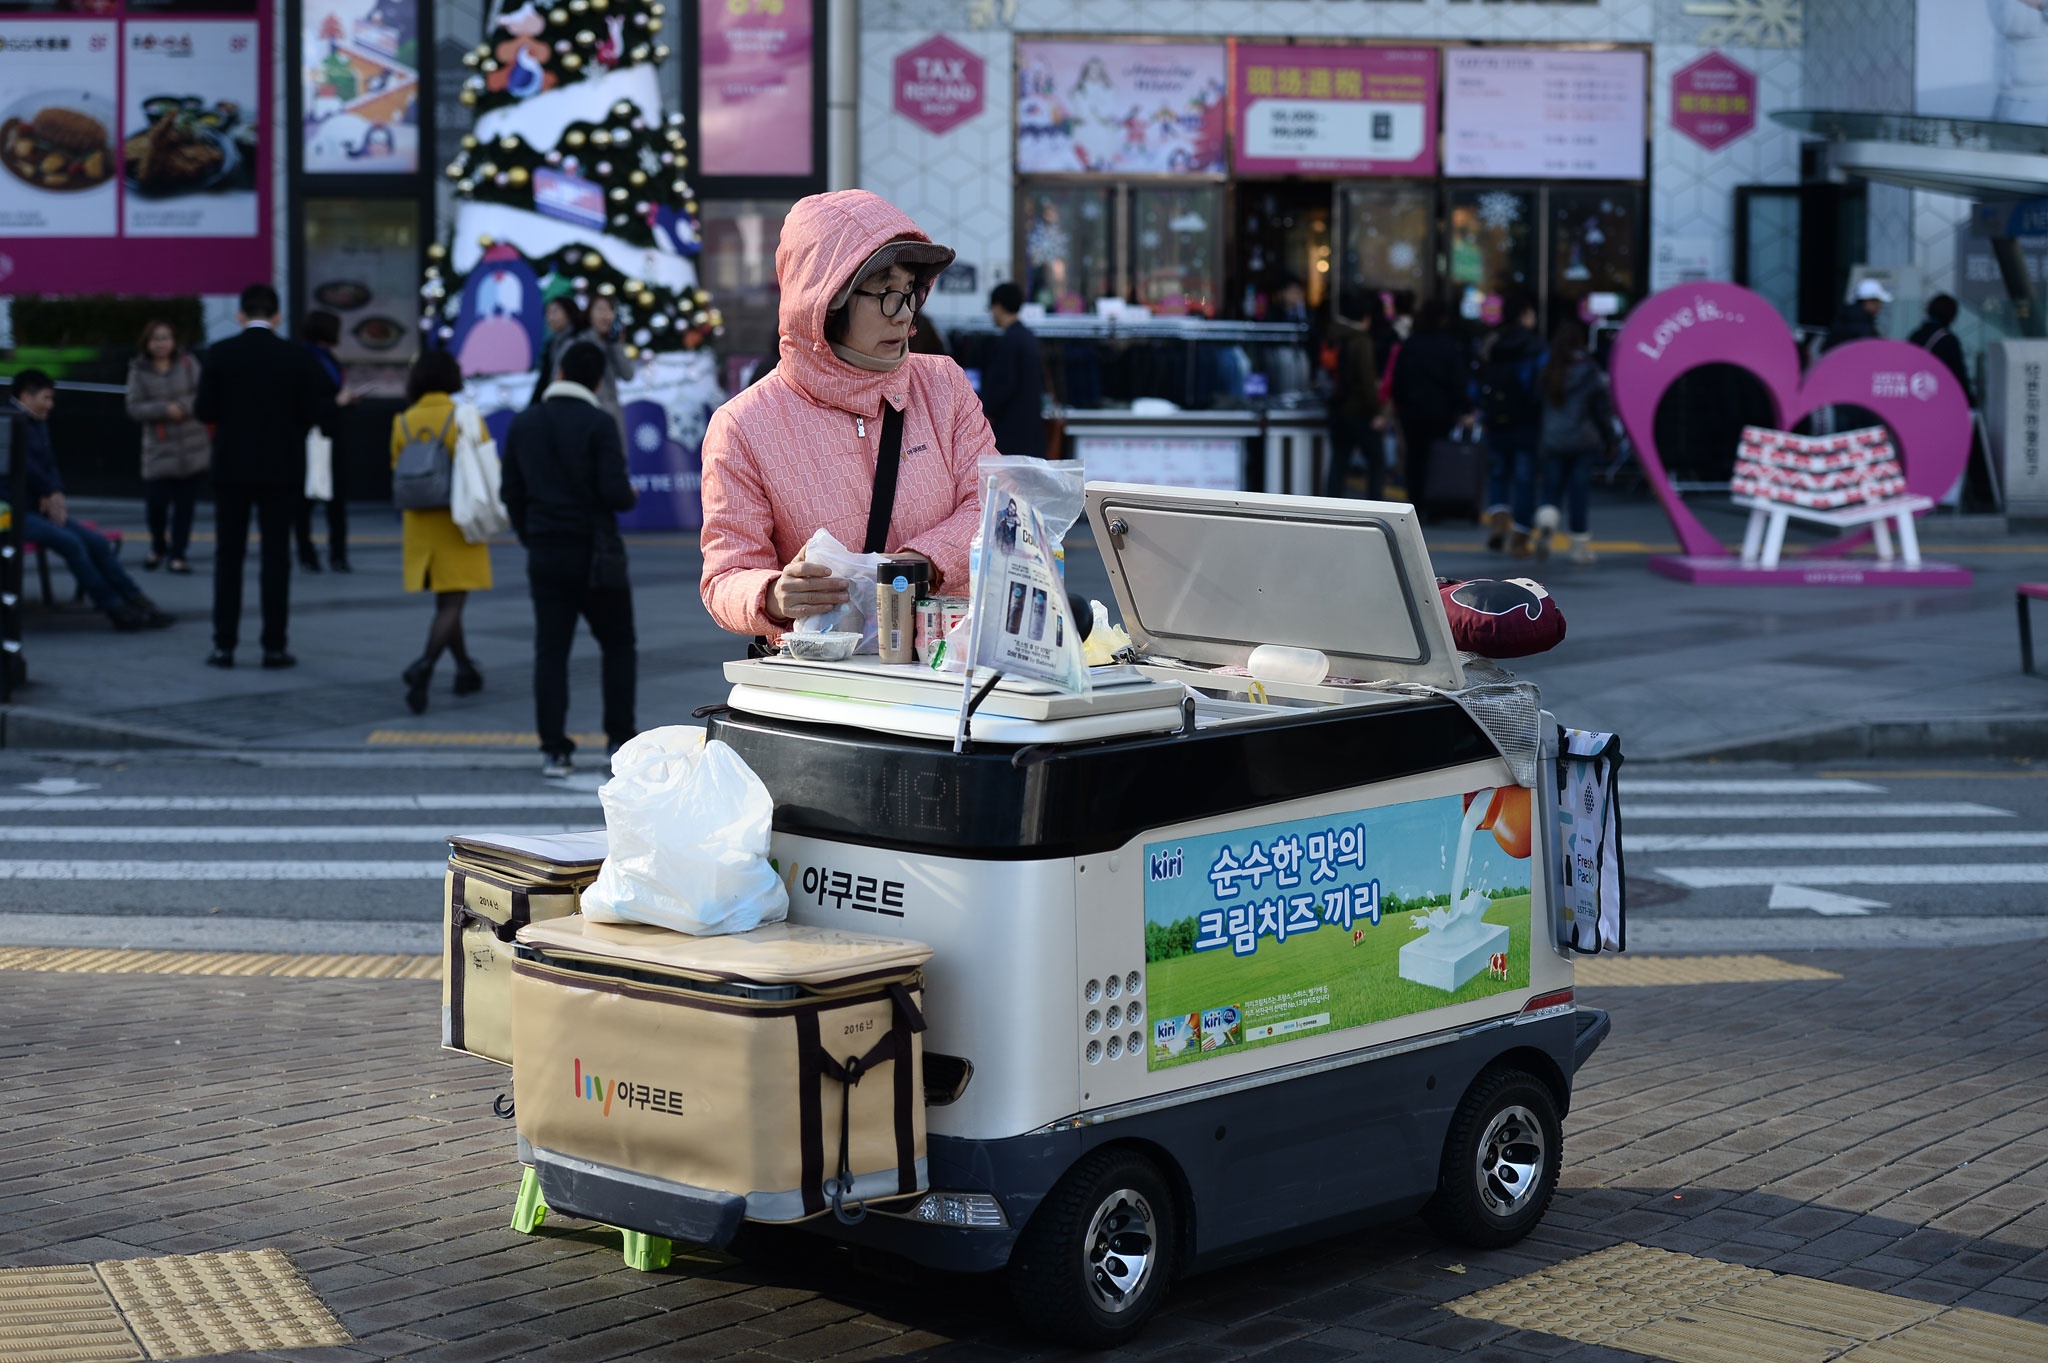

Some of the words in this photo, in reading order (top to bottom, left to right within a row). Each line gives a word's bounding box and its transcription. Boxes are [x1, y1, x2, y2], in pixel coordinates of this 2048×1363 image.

[913, 57, 968, 80] TAX
[1637, 306, 1696, 360] Love
[1150, 847, 1183, 882] kiri
[1209, 836, 1303, 897] 순수한
[1307, 825, 1365, 883] 맛의
[1577, 853, 1595, 870] Fresh
[802, 866, 905, 918] 야쿠르트
[1195, 895, 1319, 954] 크림치즈
[1323, 881, 1379, 929] 끼리
[1157, 1020, 1176, 1039] kiri
[1204, 1011, 1221, 1029] kiri
[617, 1081, 684, 1117] 야쿠르트
